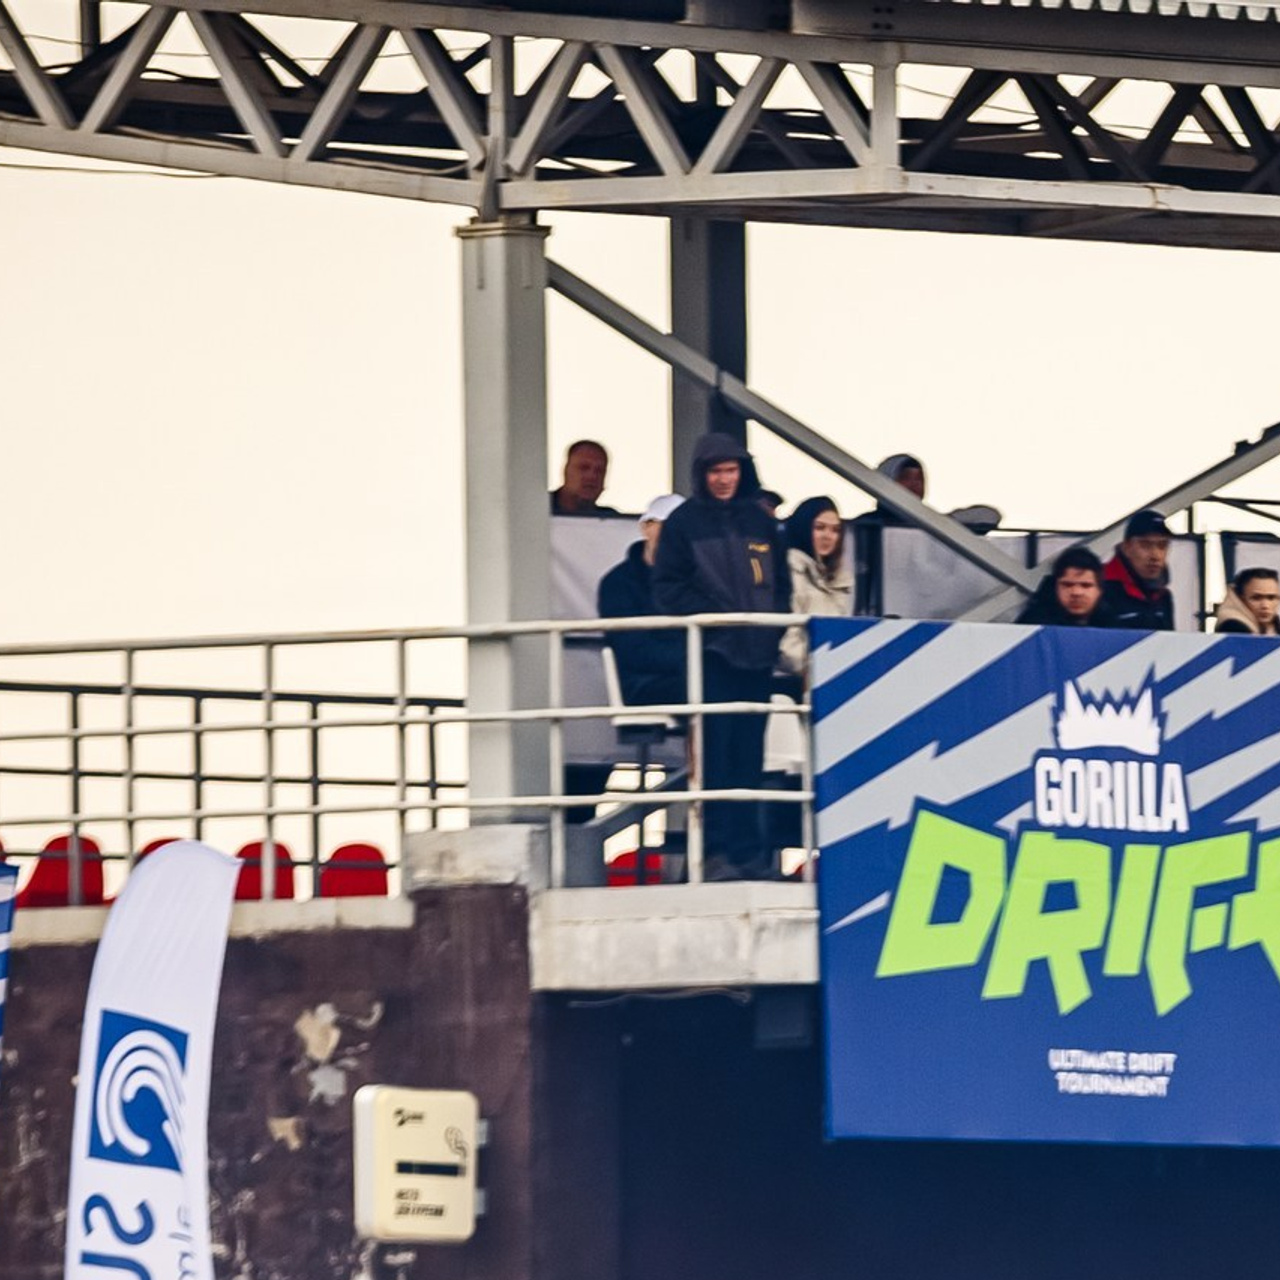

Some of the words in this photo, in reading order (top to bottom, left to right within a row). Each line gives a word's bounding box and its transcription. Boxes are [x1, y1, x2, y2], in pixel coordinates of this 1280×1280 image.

[1034, 756, 1190, 833] GORILLA
[1048, 1049, 1126, 1072] ULTIMATE
[1128, 1052, 1177, 1074] DRIFT
[1055, 1071, 1170, 1097] TOURNAMENT
